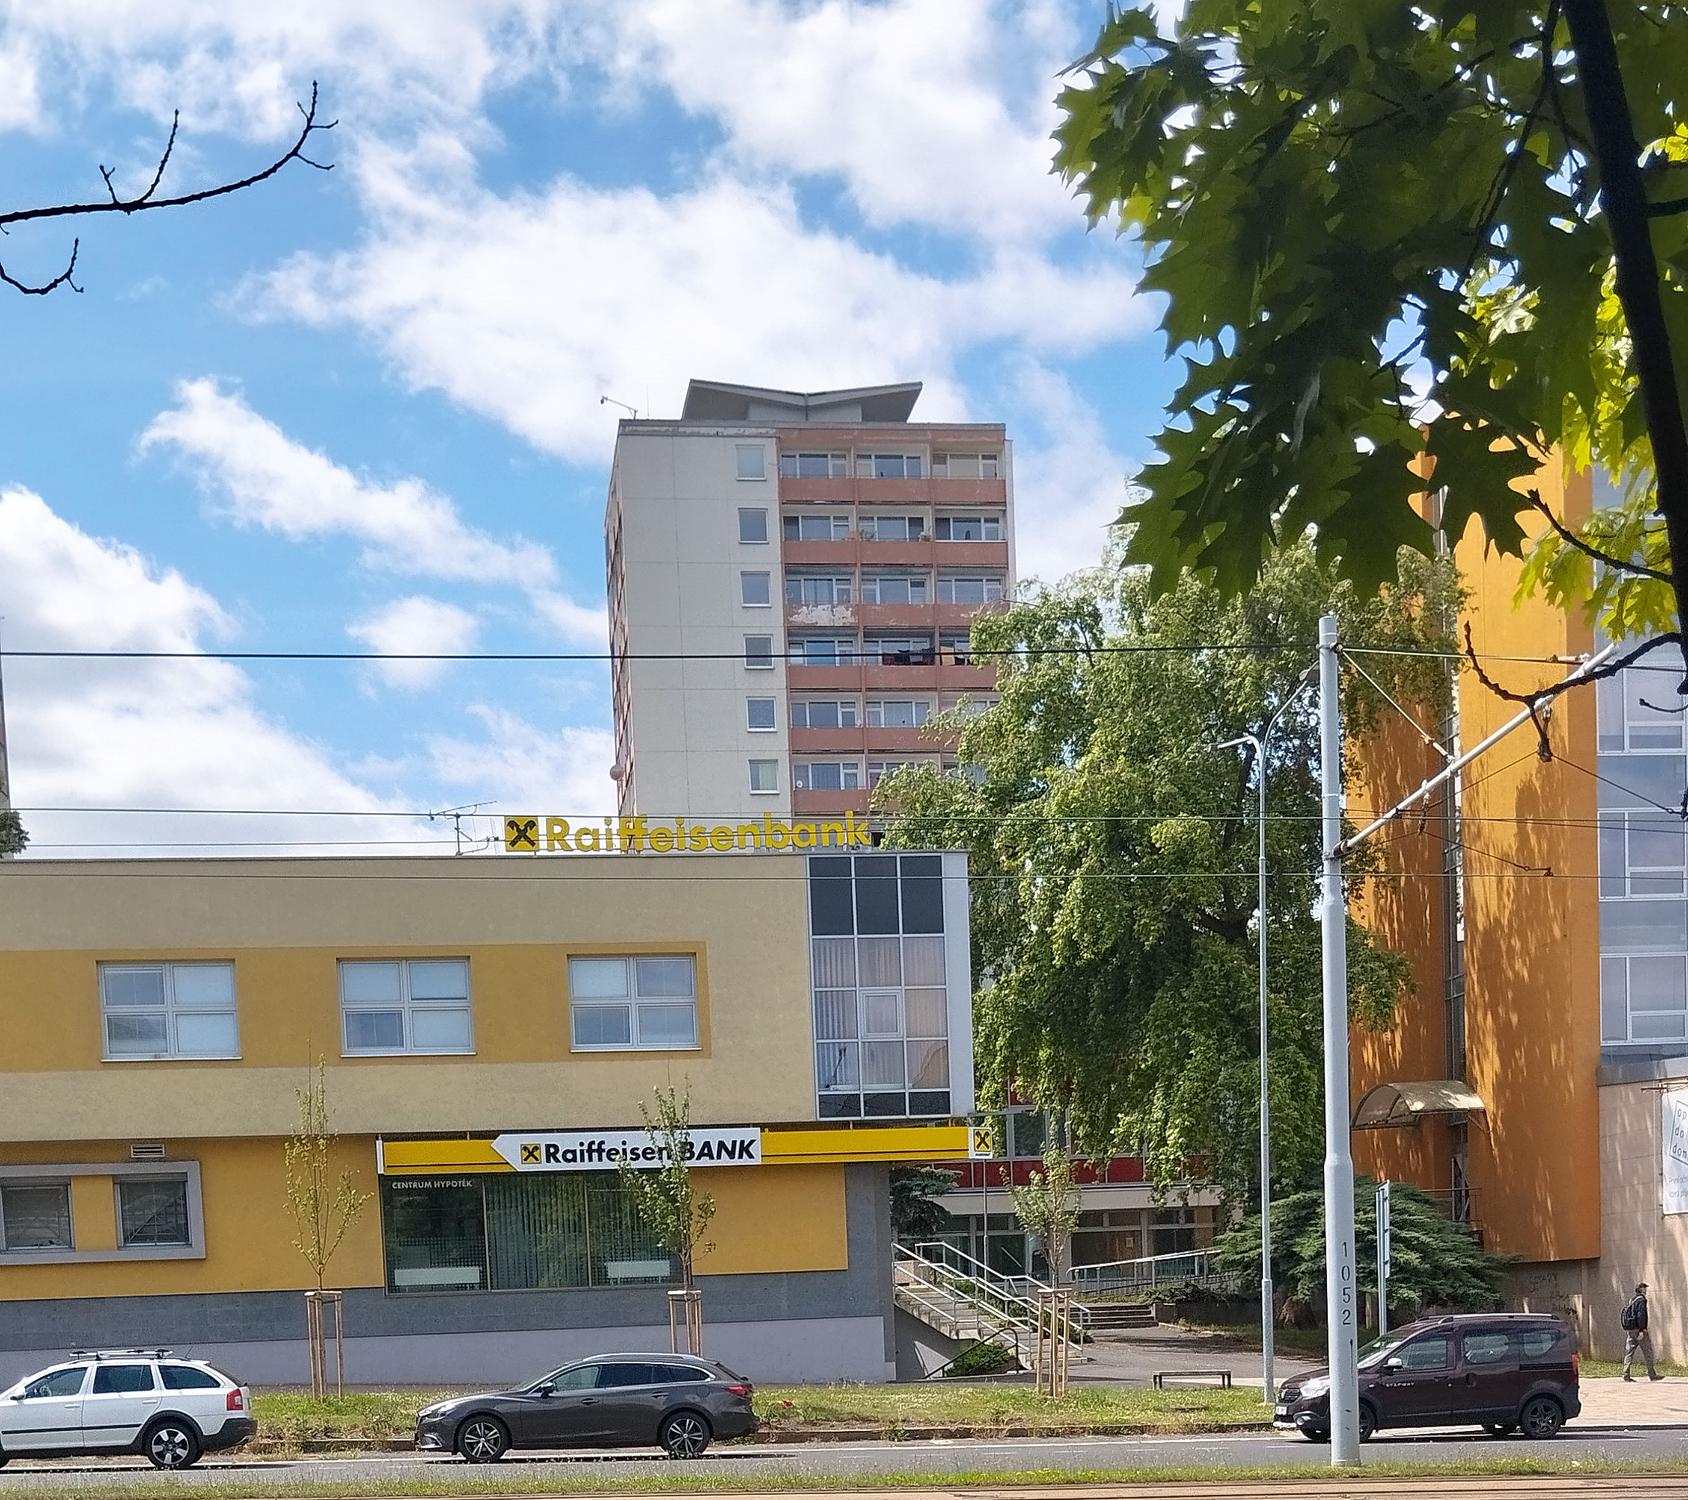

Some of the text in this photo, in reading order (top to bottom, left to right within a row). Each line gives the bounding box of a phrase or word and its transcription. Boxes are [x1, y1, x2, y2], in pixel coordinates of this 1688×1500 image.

[545, 811, 871, 851] Raiffeisenbank
[544, 1139, 756, 1163] Raiffeisen BANK
[391, 1178, 473, 1189] CENTRUM HYPOTÉK
[1340, 1241, 1351, 1326] 1052
